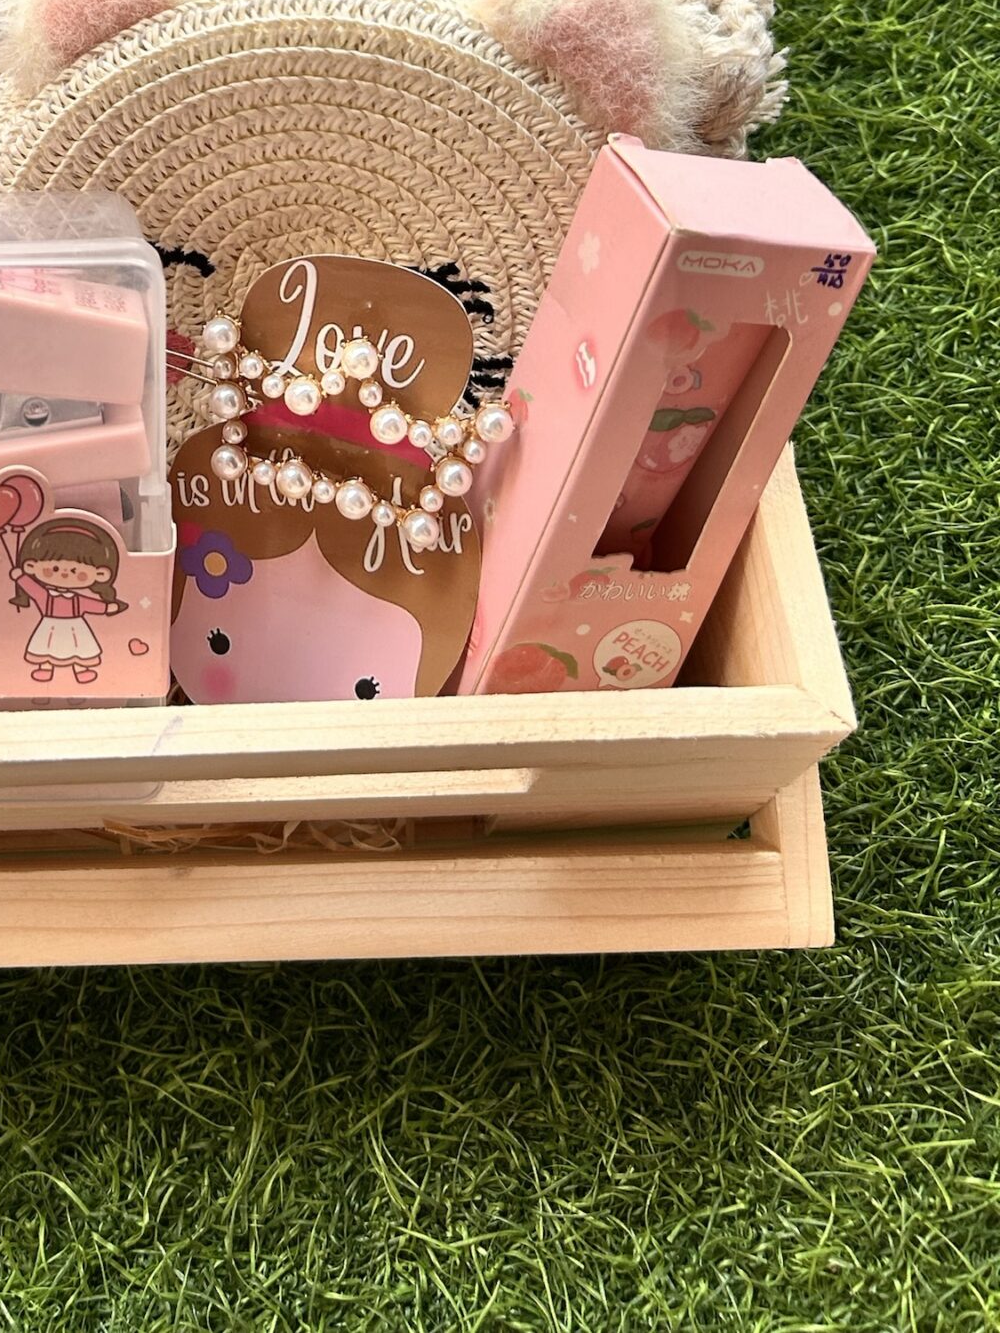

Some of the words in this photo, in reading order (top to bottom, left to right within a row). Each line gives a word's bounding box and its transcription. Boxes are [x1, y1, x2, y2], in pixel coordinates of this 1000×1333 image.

[681, 255, 757, 274] MOKA
[176, 471, 210, 508] is
[611, 631, 670, 673] PEACH
